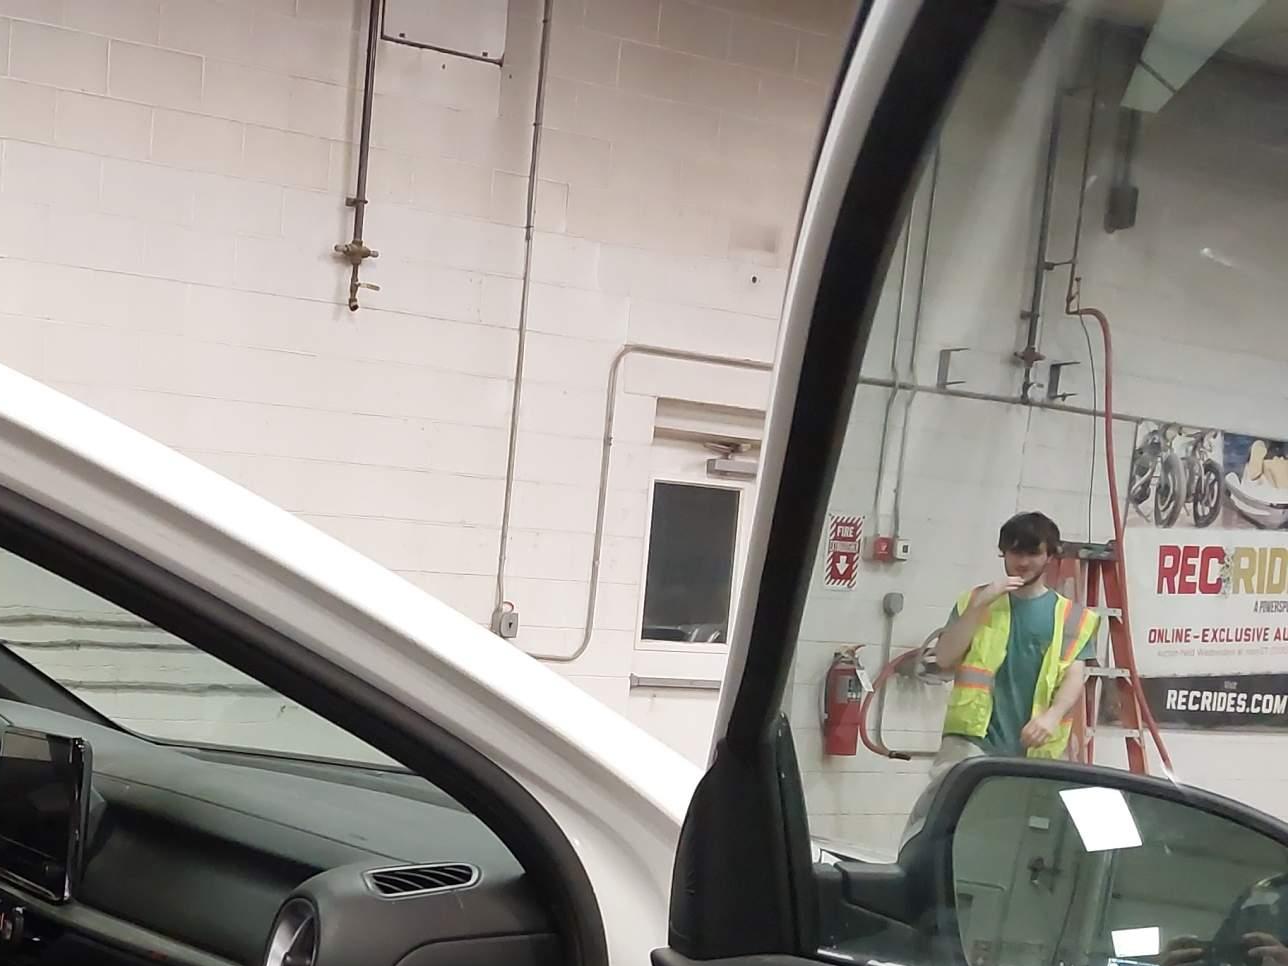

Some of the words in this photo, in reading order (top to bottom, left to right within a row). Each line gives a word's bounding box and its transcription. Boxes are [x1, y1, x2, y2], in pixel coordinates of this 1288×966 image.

[837, 525, 855, 538] FIRE
[1157, 545, 1227, 595] REC
[1232, 546, 1288, 595] RID
[1148, 627, 1269, 644] ONLINE-EXCLUSIVE
[1166, 689, 1288, 714] RECRIDES.COM
